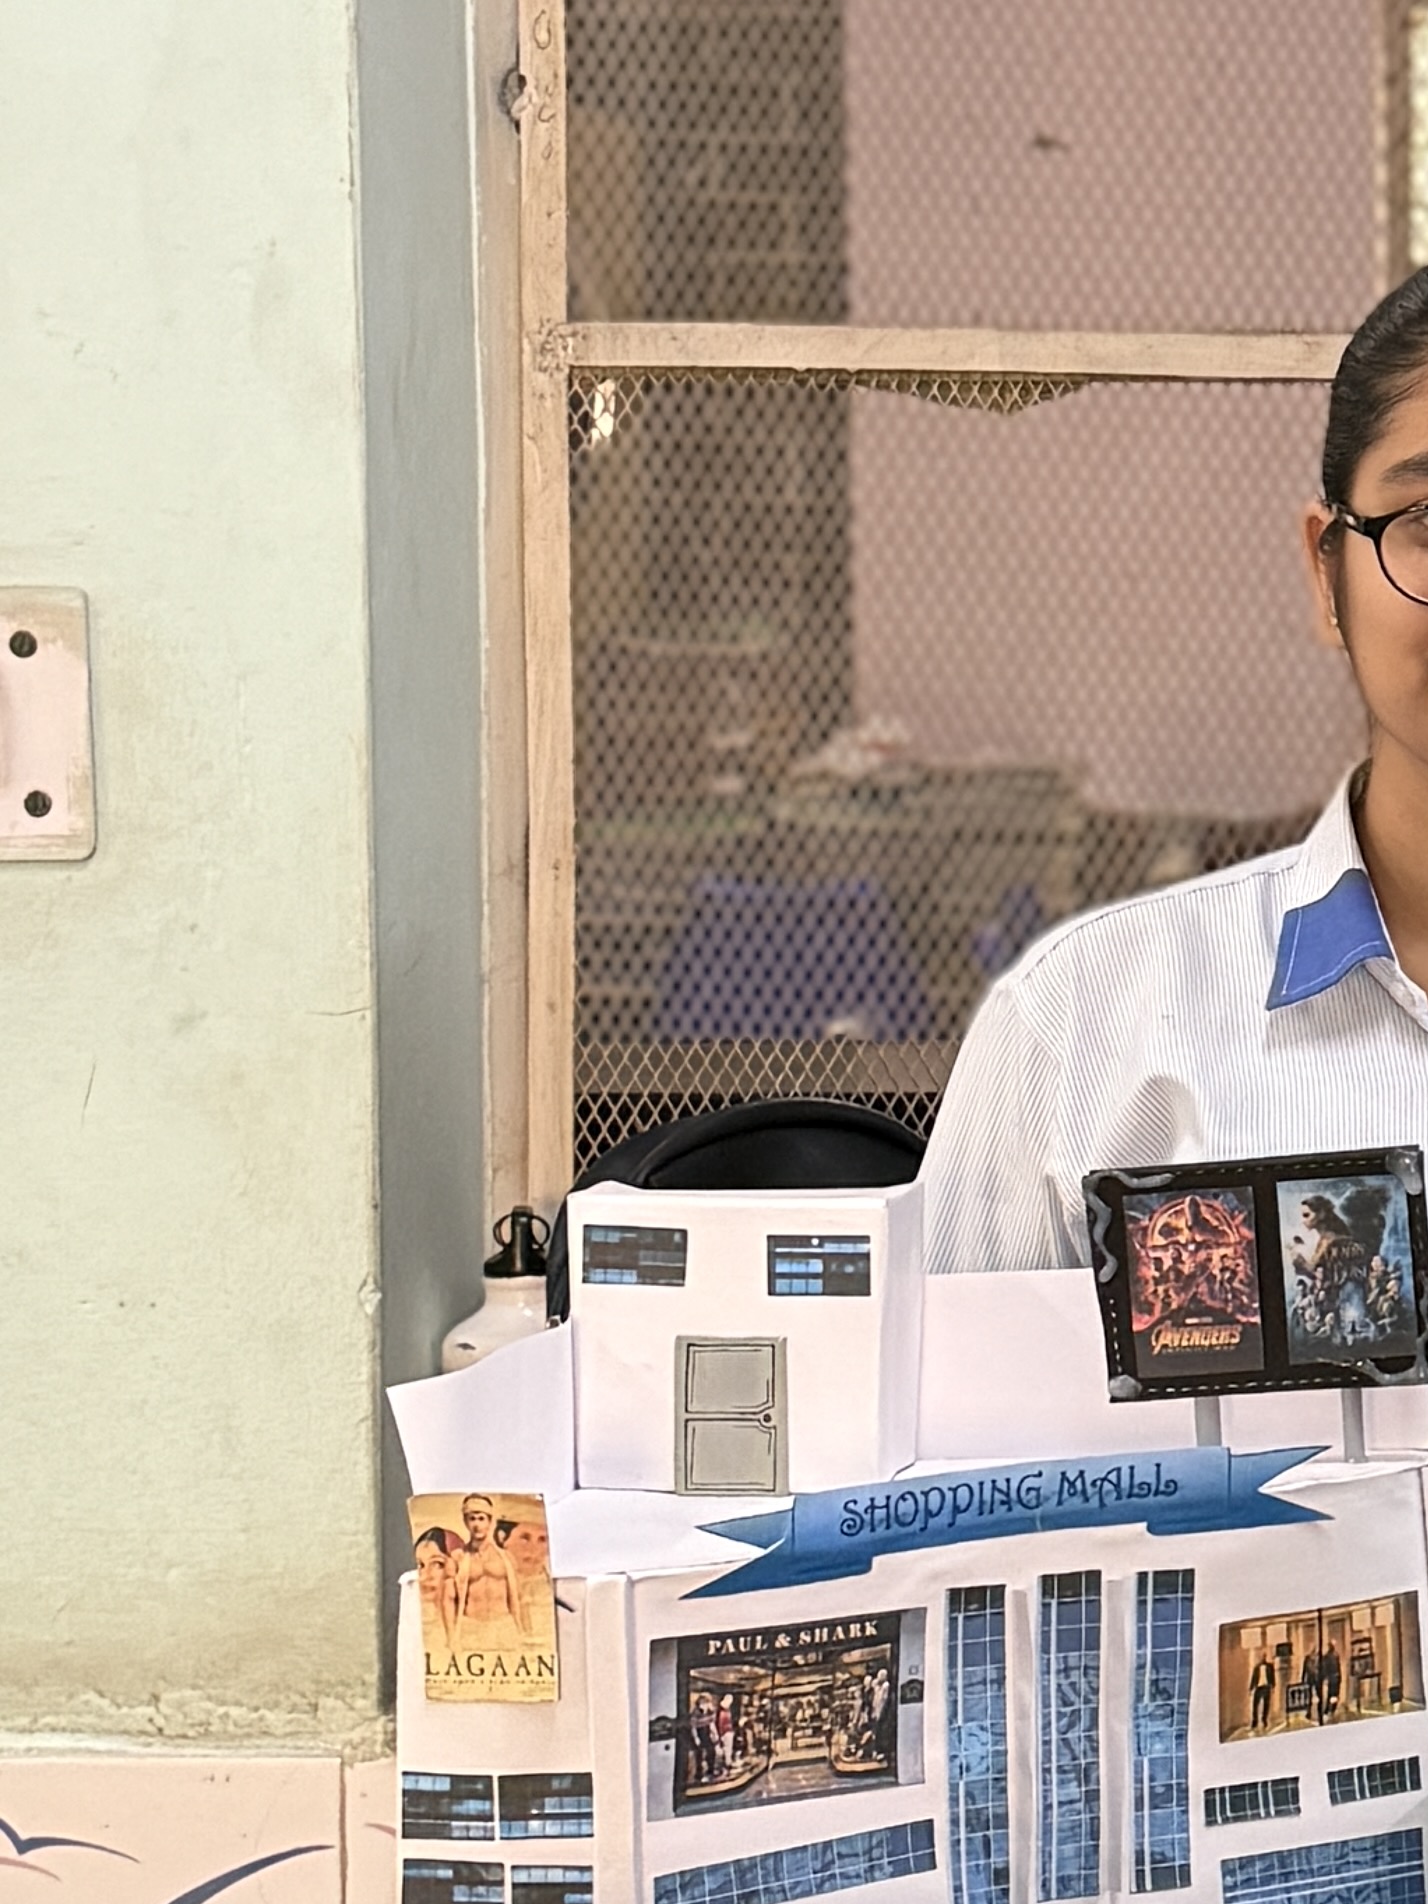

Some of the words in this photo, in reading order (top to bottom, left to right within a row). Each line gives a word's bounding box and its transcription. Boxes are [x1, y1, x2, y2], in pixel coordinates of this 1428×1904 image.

[839, 1470, 1044, 1538] SHOPPING
[1055, 1462, 1179, 1508] MALL
[707, 1634, 769, 1656] PAUL
[774, 1632, 792, 1649] &
[796, 1619, 880, 1647] SHARK
[423, 1651, 556, 1678] LAGAAN
